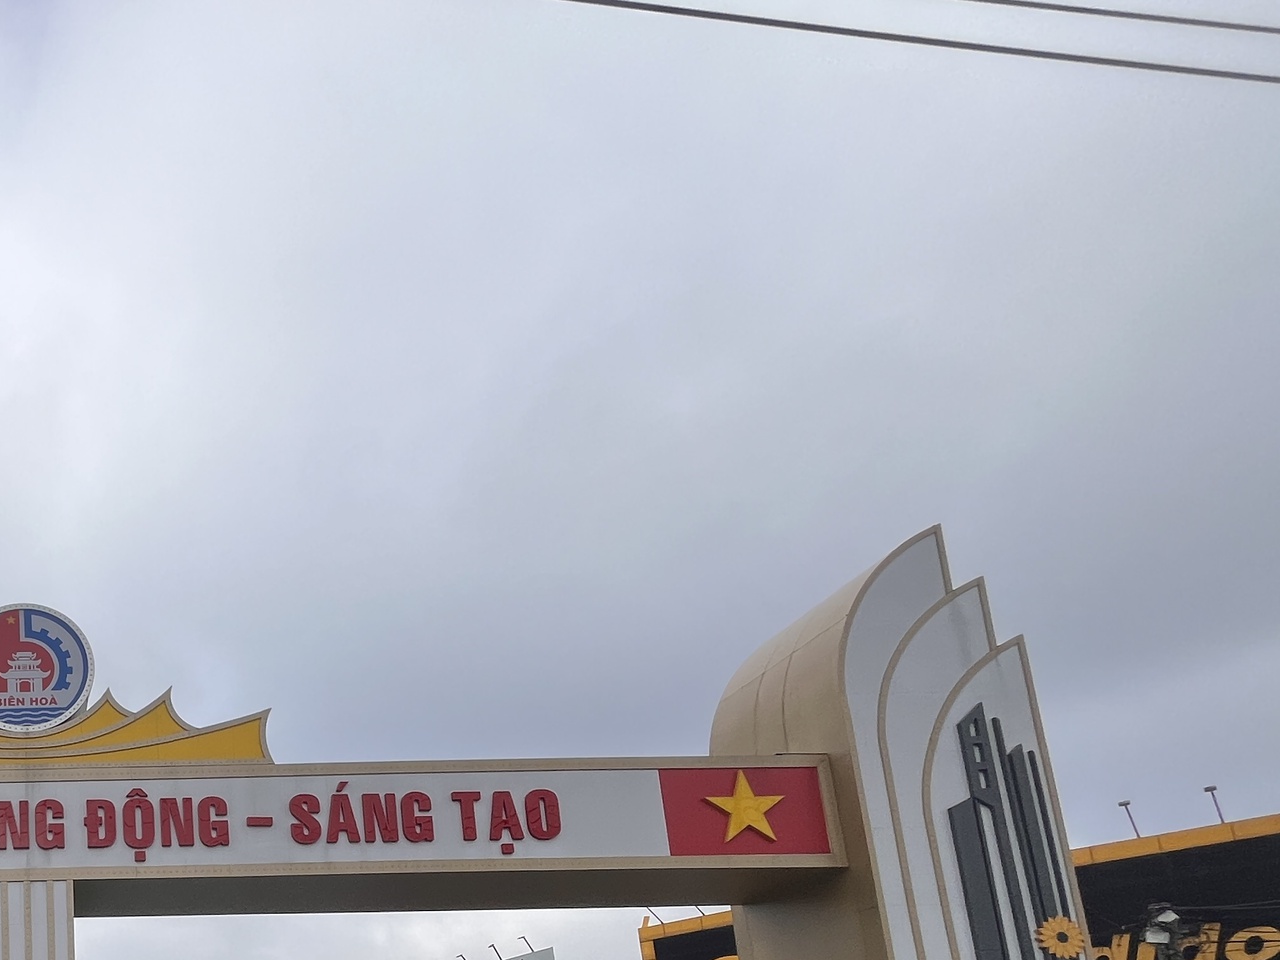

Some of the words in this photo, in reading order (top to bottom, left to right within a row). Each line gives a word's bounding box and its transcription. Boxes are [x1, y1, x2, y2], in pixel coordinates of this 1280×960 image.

[30, 695, 58, 706] HOÀ
[83, 788, 230, 863] ĐỘNG
[246, 816, 273, 828] -
[289, 781, 435, 845] SÁNG
[451, 788, 562, 855] TẠO
